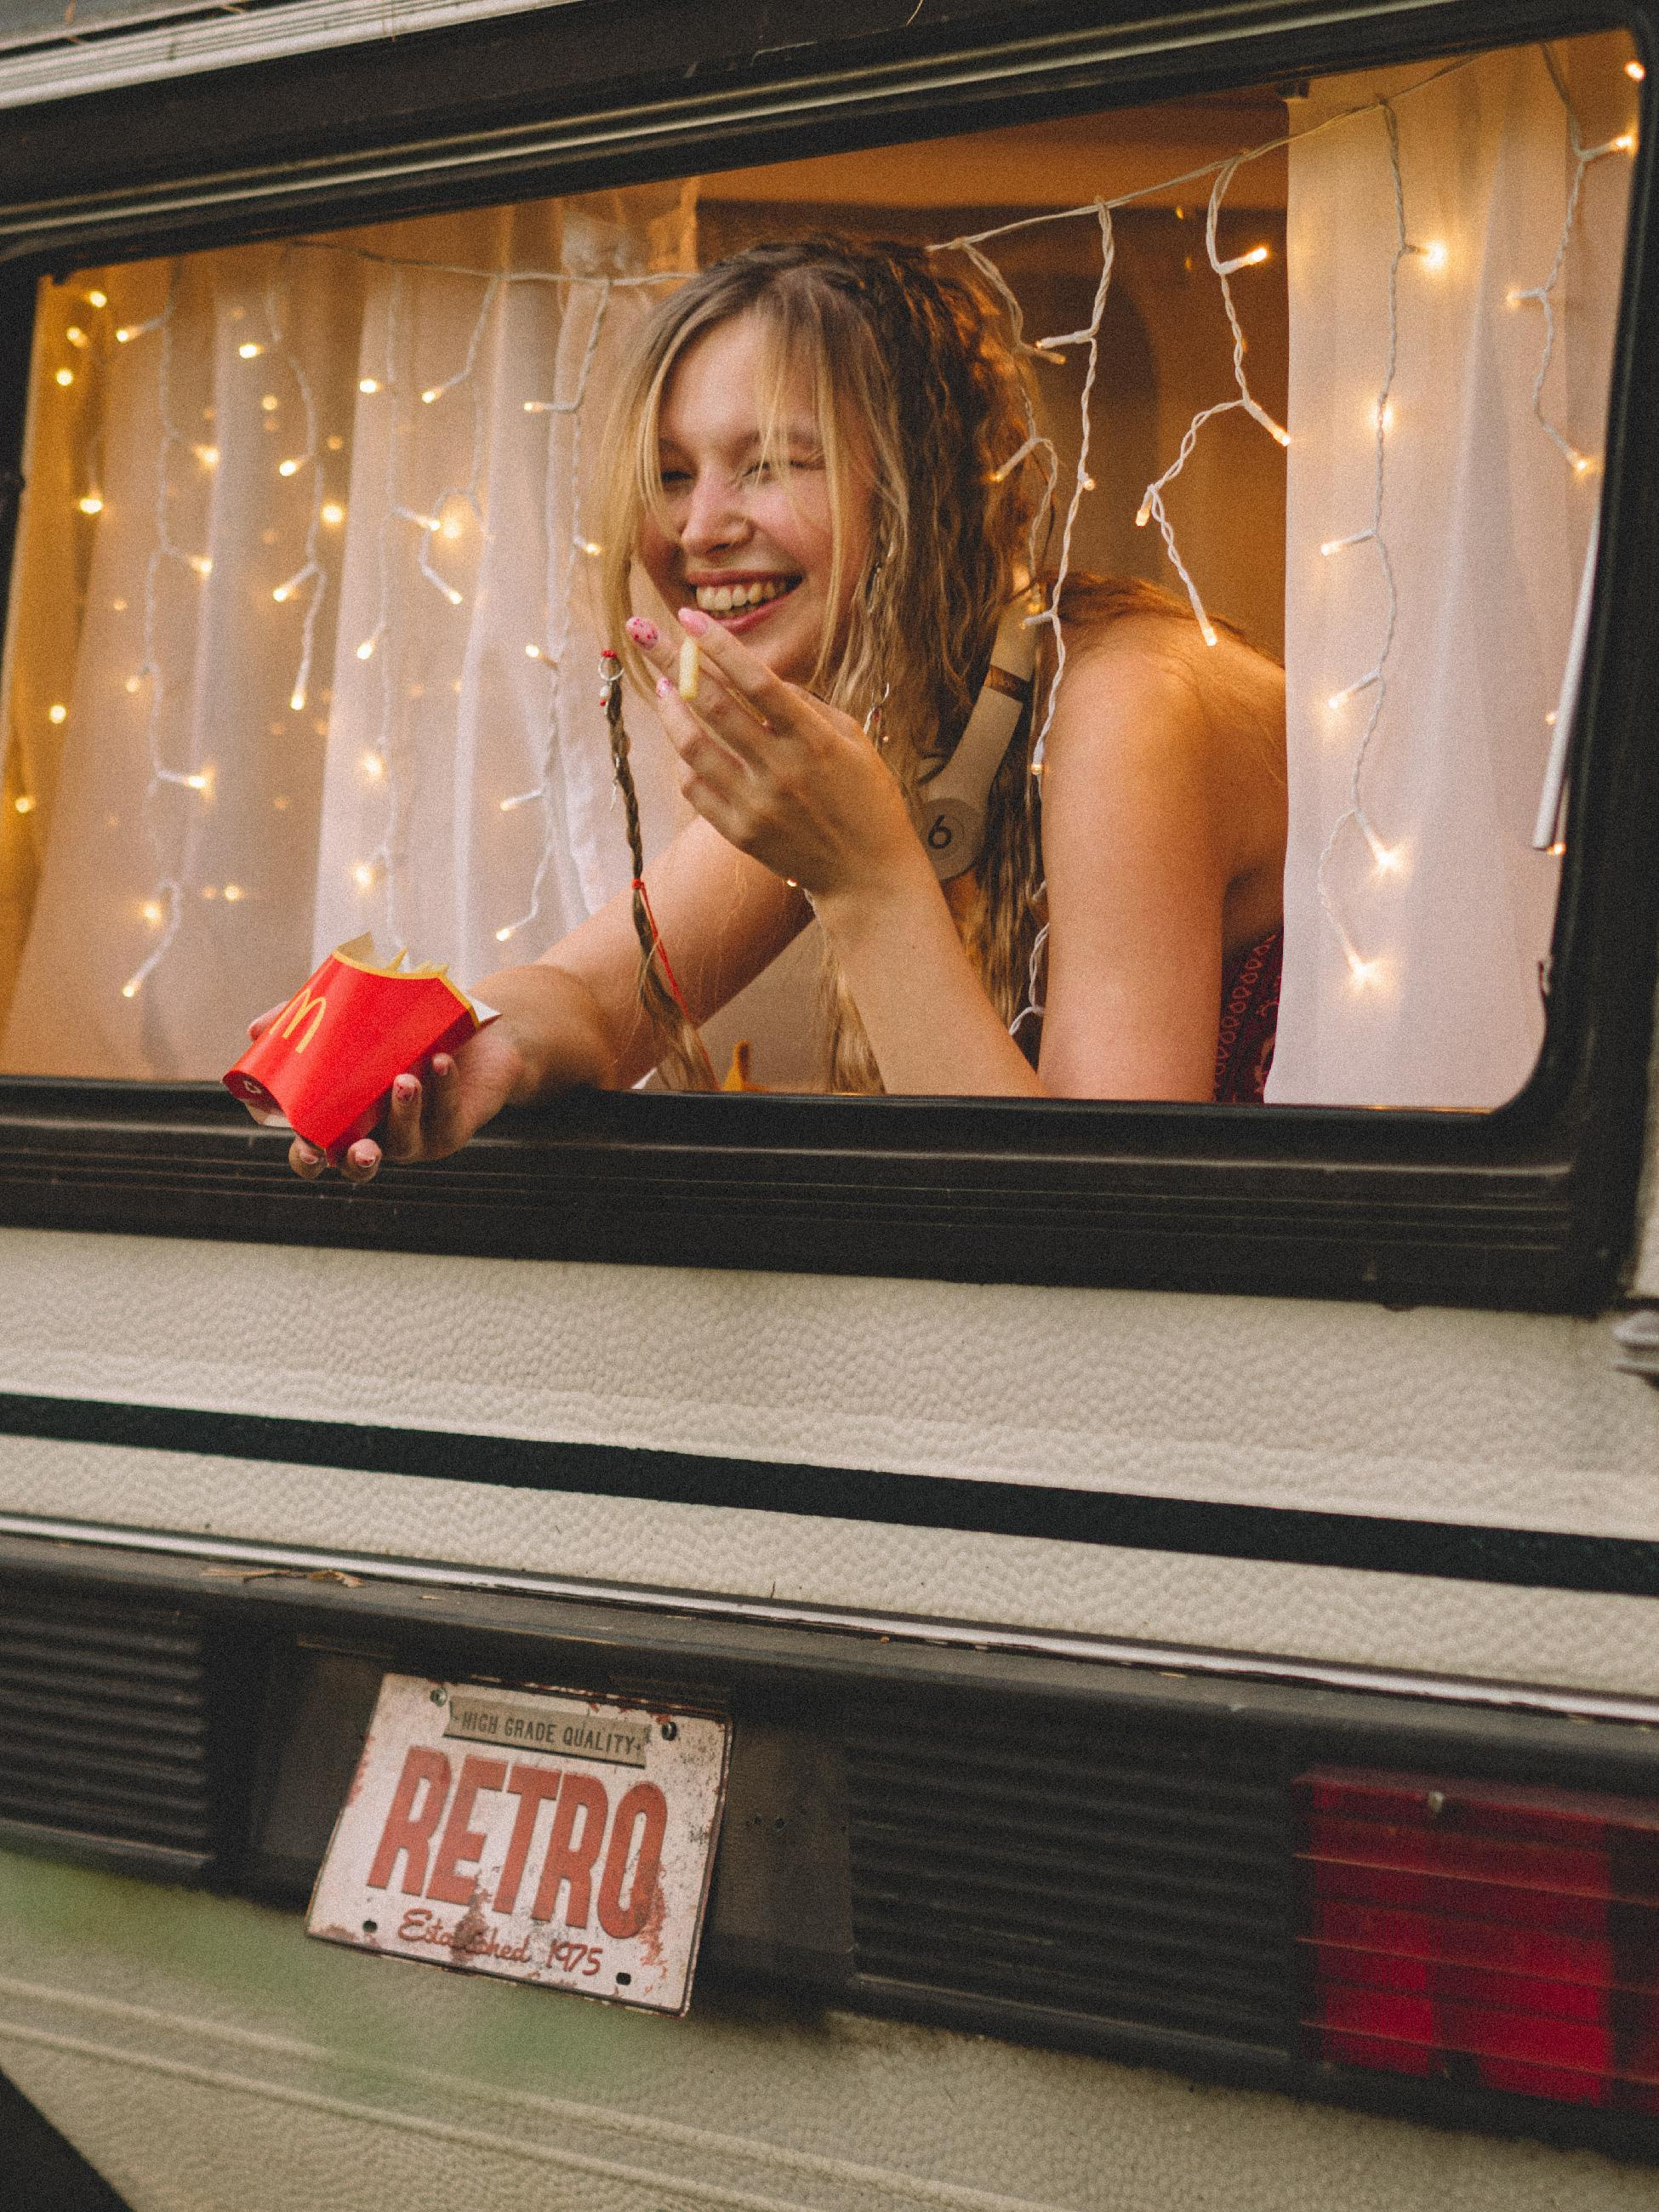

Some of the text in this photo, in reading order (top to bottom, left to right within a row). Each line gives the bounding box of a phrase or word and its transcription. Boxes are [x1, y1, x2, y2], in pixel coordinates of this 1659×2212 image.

[462, 1711, 499, 1735] HIGH
[504, 1717, 557, 1743] GRADE
[367, 1745, 669, 1939] RETRO
[546, 1938, 604, 1975] 1975
